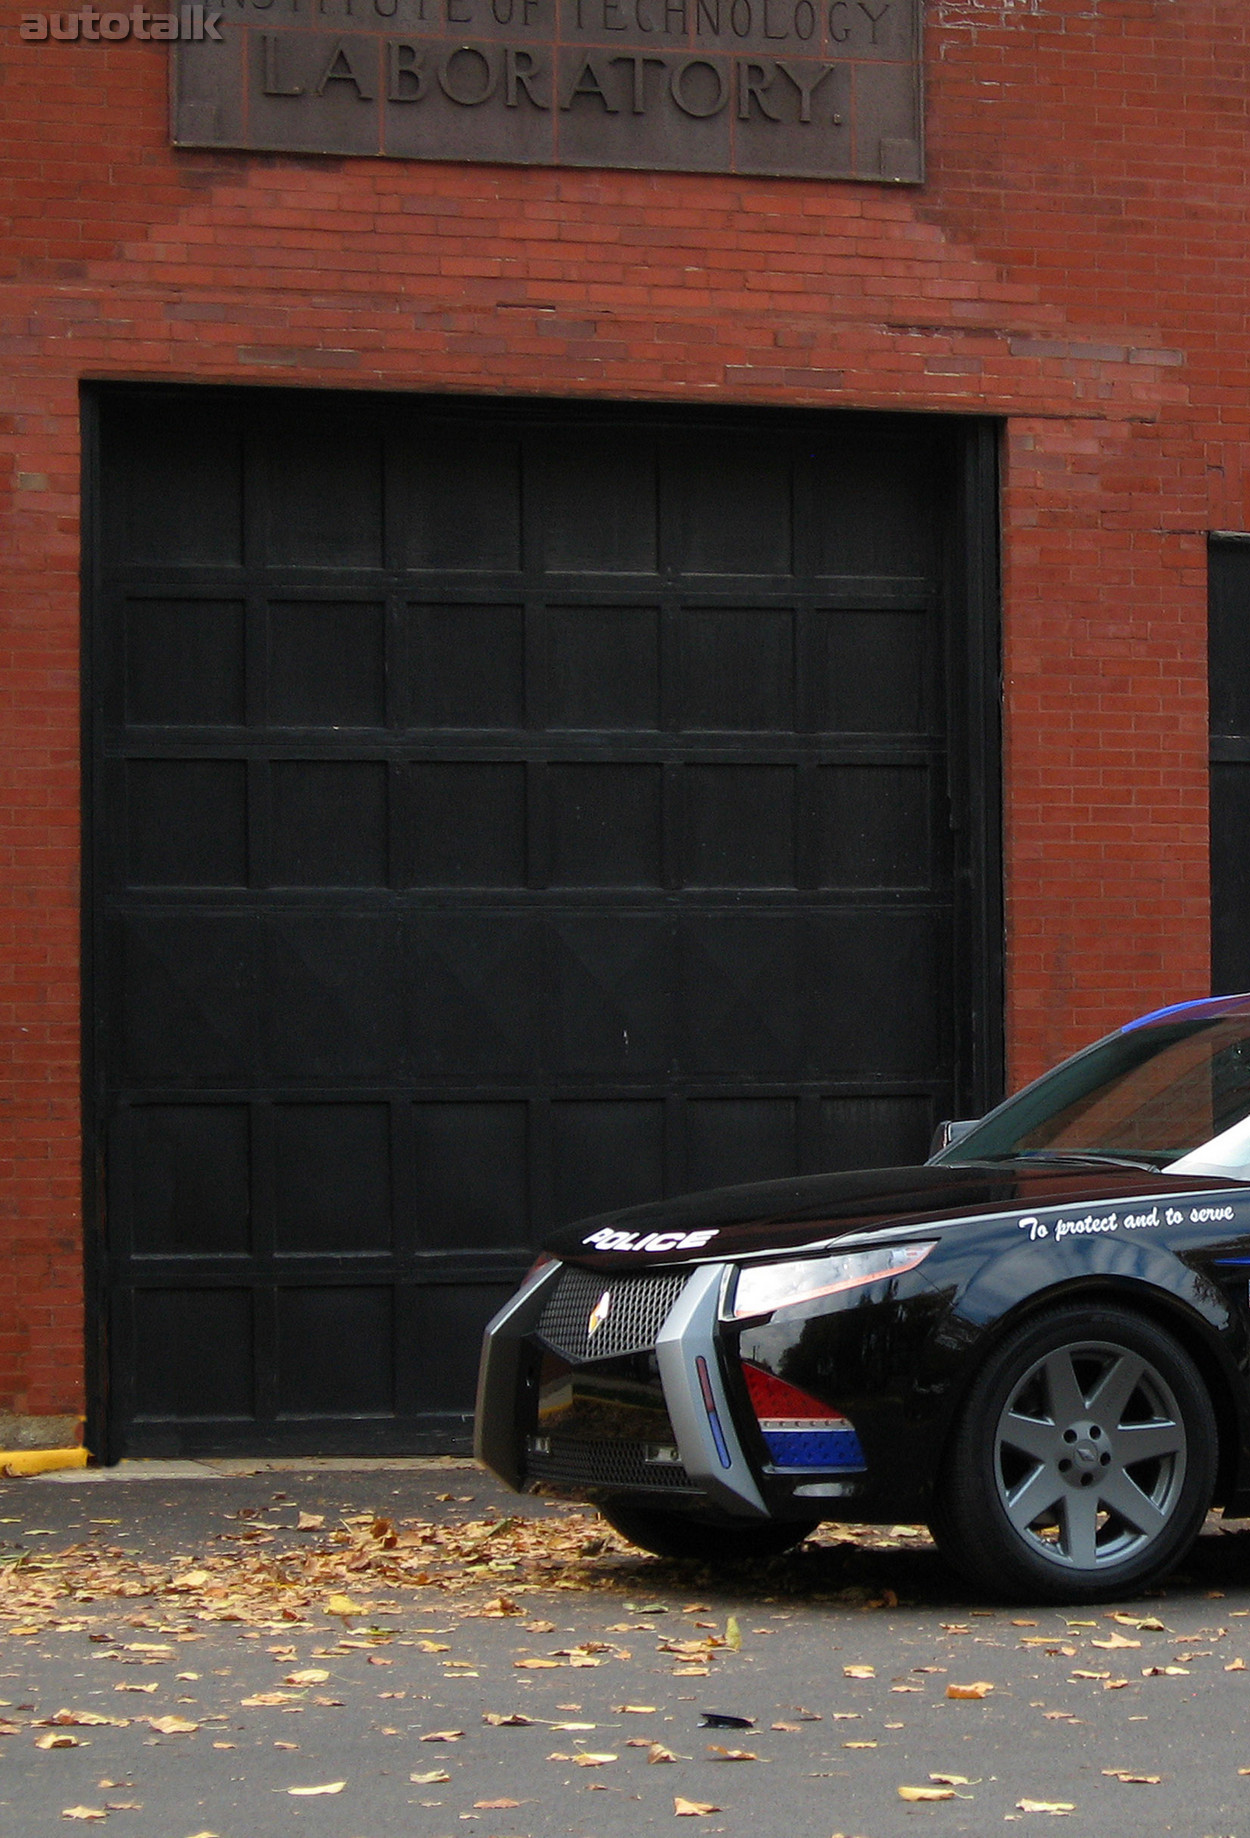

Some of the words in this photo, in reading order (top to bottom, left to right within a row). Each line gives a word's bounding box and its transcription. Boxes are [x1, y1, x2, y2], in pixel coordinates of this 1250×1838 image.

[575, 0, 889, 45] TECHNOLOGY
[582, 1227, 720, 1252] POLICE
[1018, 1217, 1048, 1241] To
[1054, 1212, 1118, 1242] protect
[1123, 1206, 1160, 1229] and
[1165, 1207, 1184, 1226] to
[1190, 1205, 1234, 1223] serve
